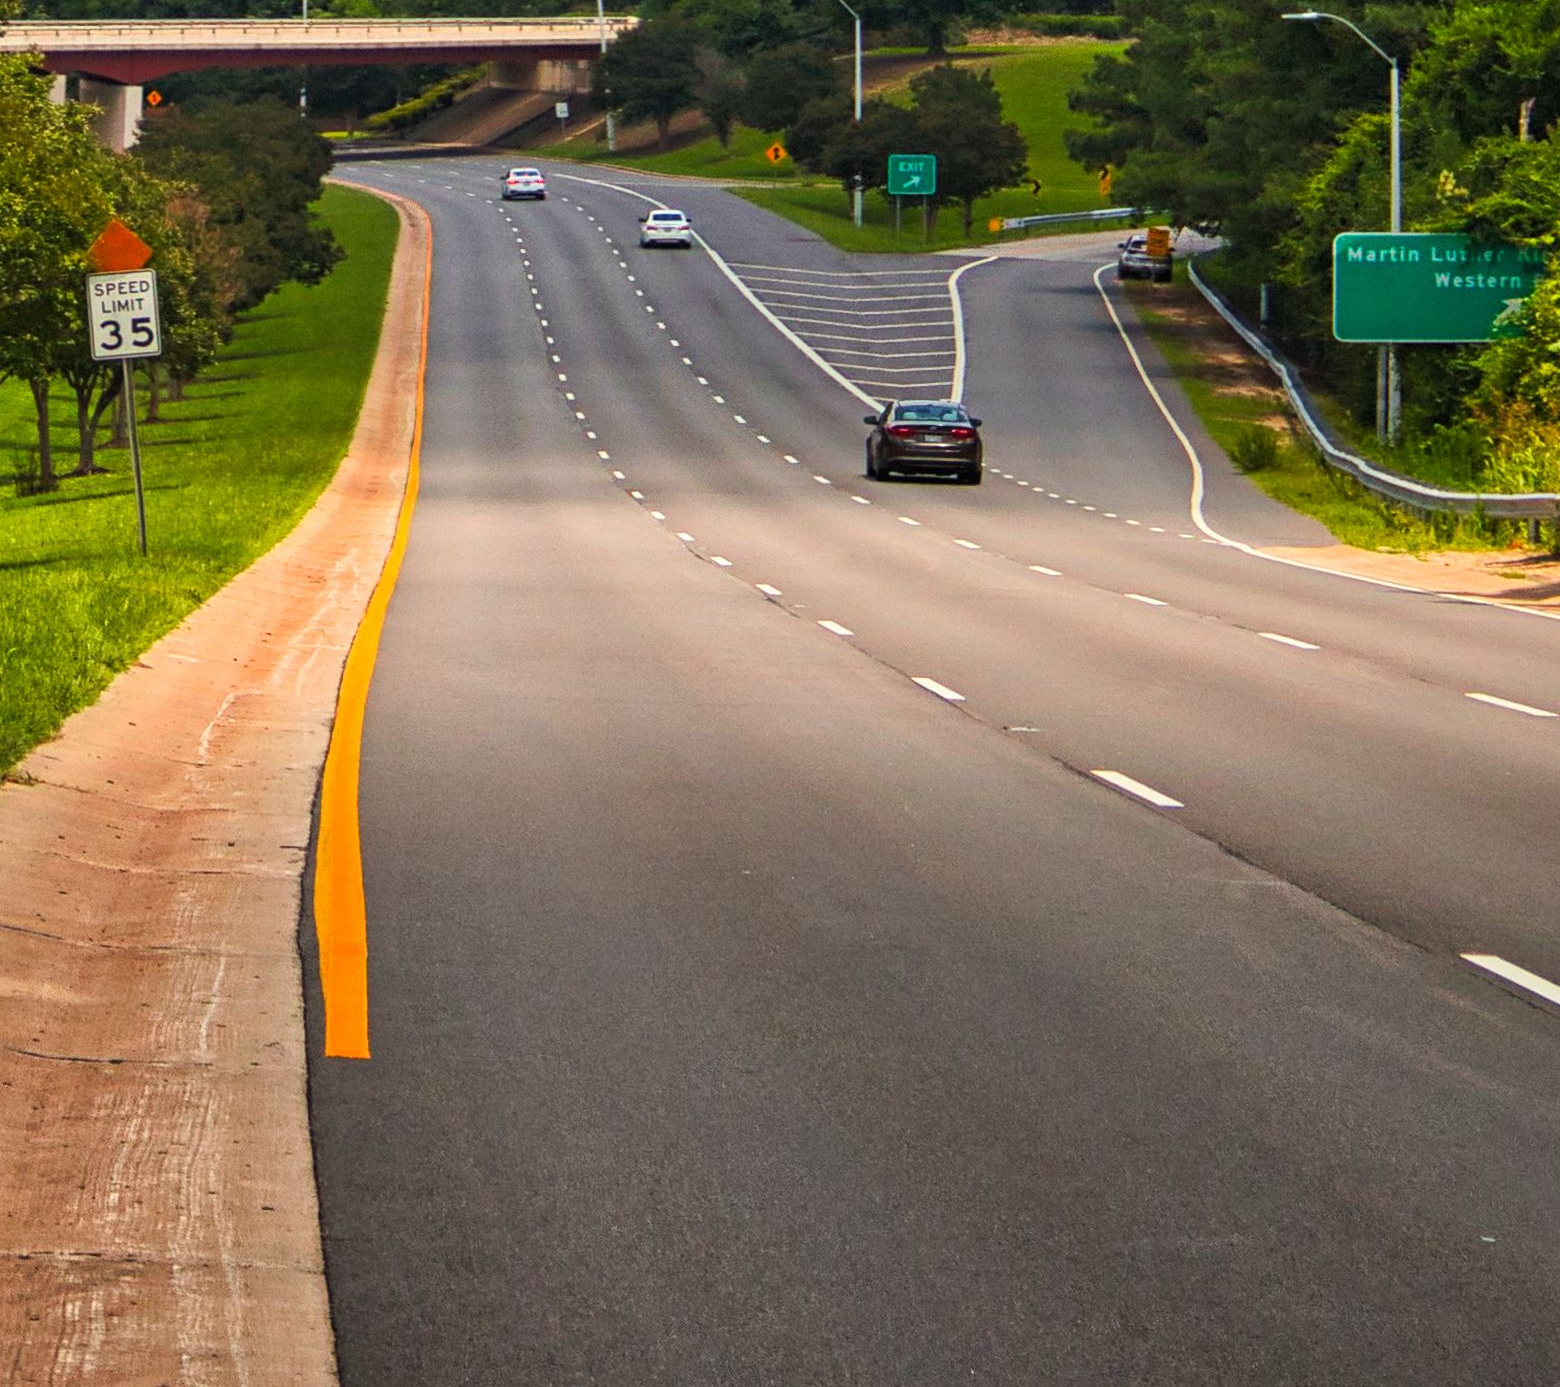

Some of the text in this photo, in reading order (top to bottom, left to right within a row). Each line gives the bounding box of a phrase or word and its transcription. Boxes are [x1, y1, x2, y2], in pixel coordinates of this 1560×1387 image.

[899, 162, 924, 171] EXIT
[1348, 246, 1419, 262] Martin
[1431, 246, 1505, 262] Luter
[94, 280, 150, 296] SPEED
[1435, 272, 1522, 288] Western
[101, 298, 144, 313] LIMIT
[100, 317, 154, 350] 35
